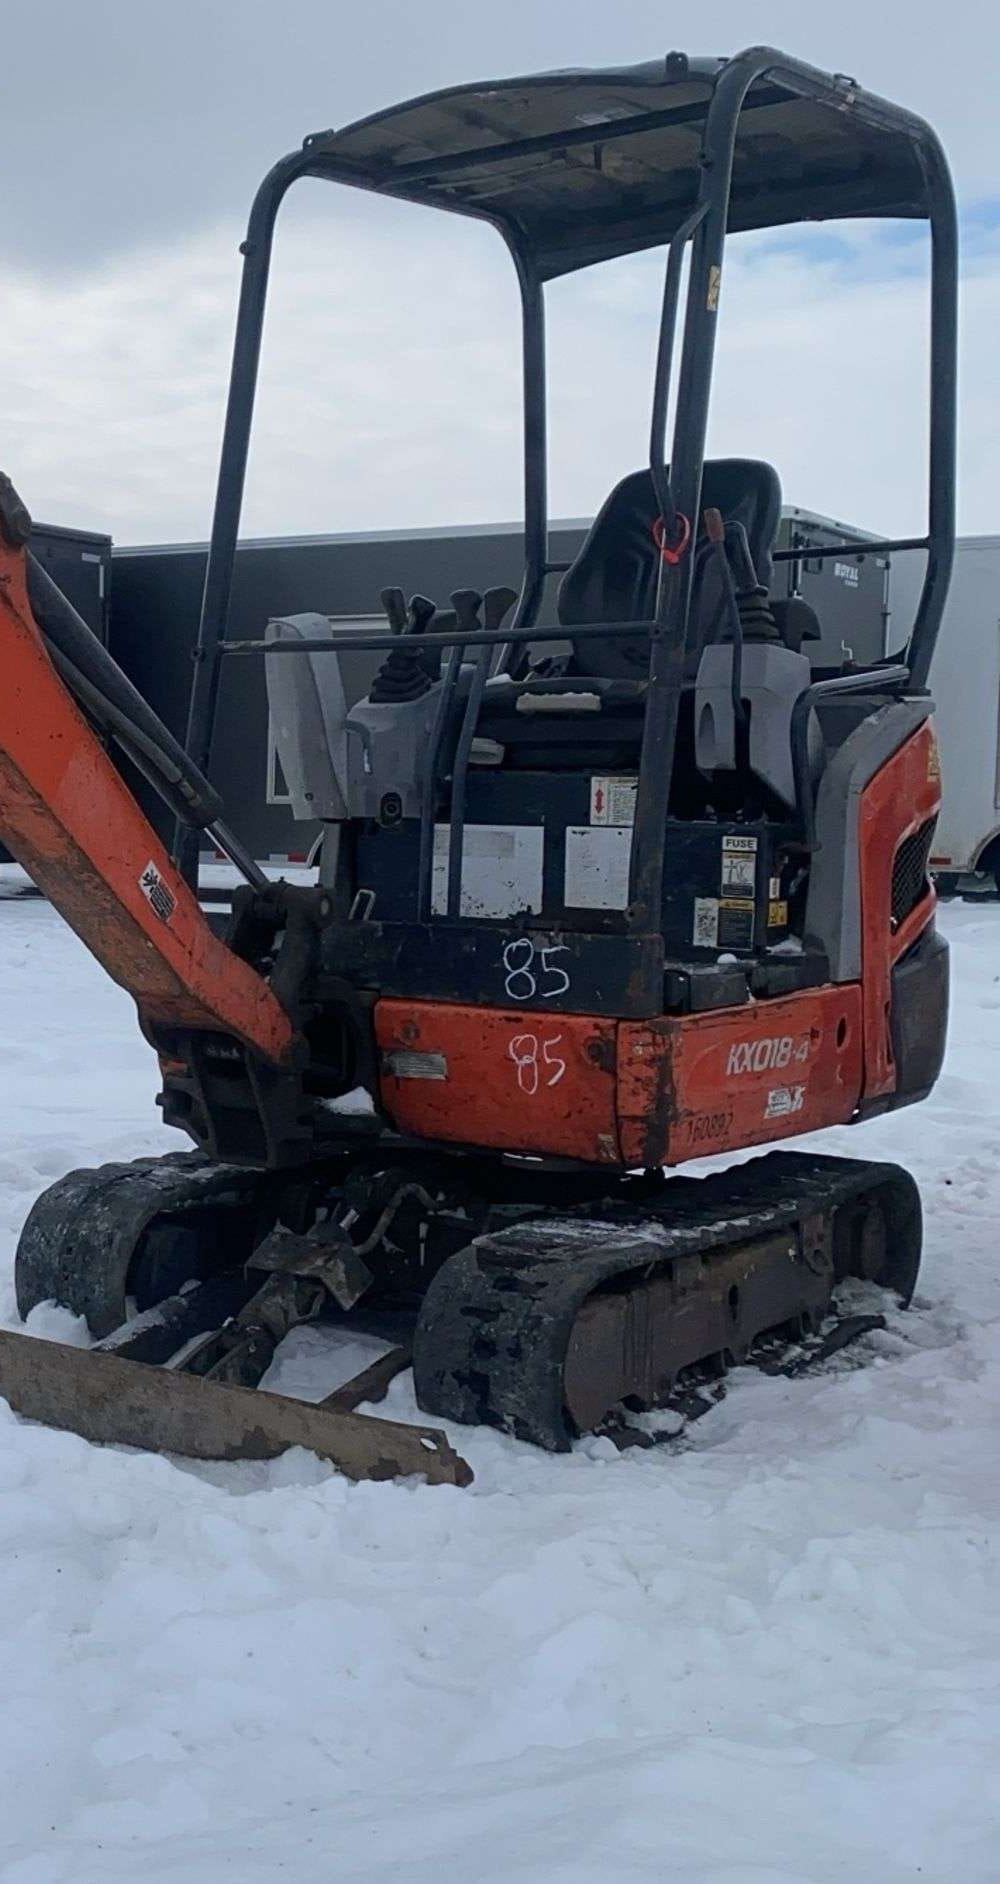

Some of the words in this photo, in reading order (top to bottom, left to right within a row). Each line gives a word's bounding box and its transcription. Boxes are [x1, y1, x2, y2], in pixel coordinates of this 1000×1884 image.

[725, 839, 755, 849] FUSE
[503, 938, 571, 1000] 85
[509, 1034, 566, 1094] 85
[726, 1037, 809, 1076] KX018-4
